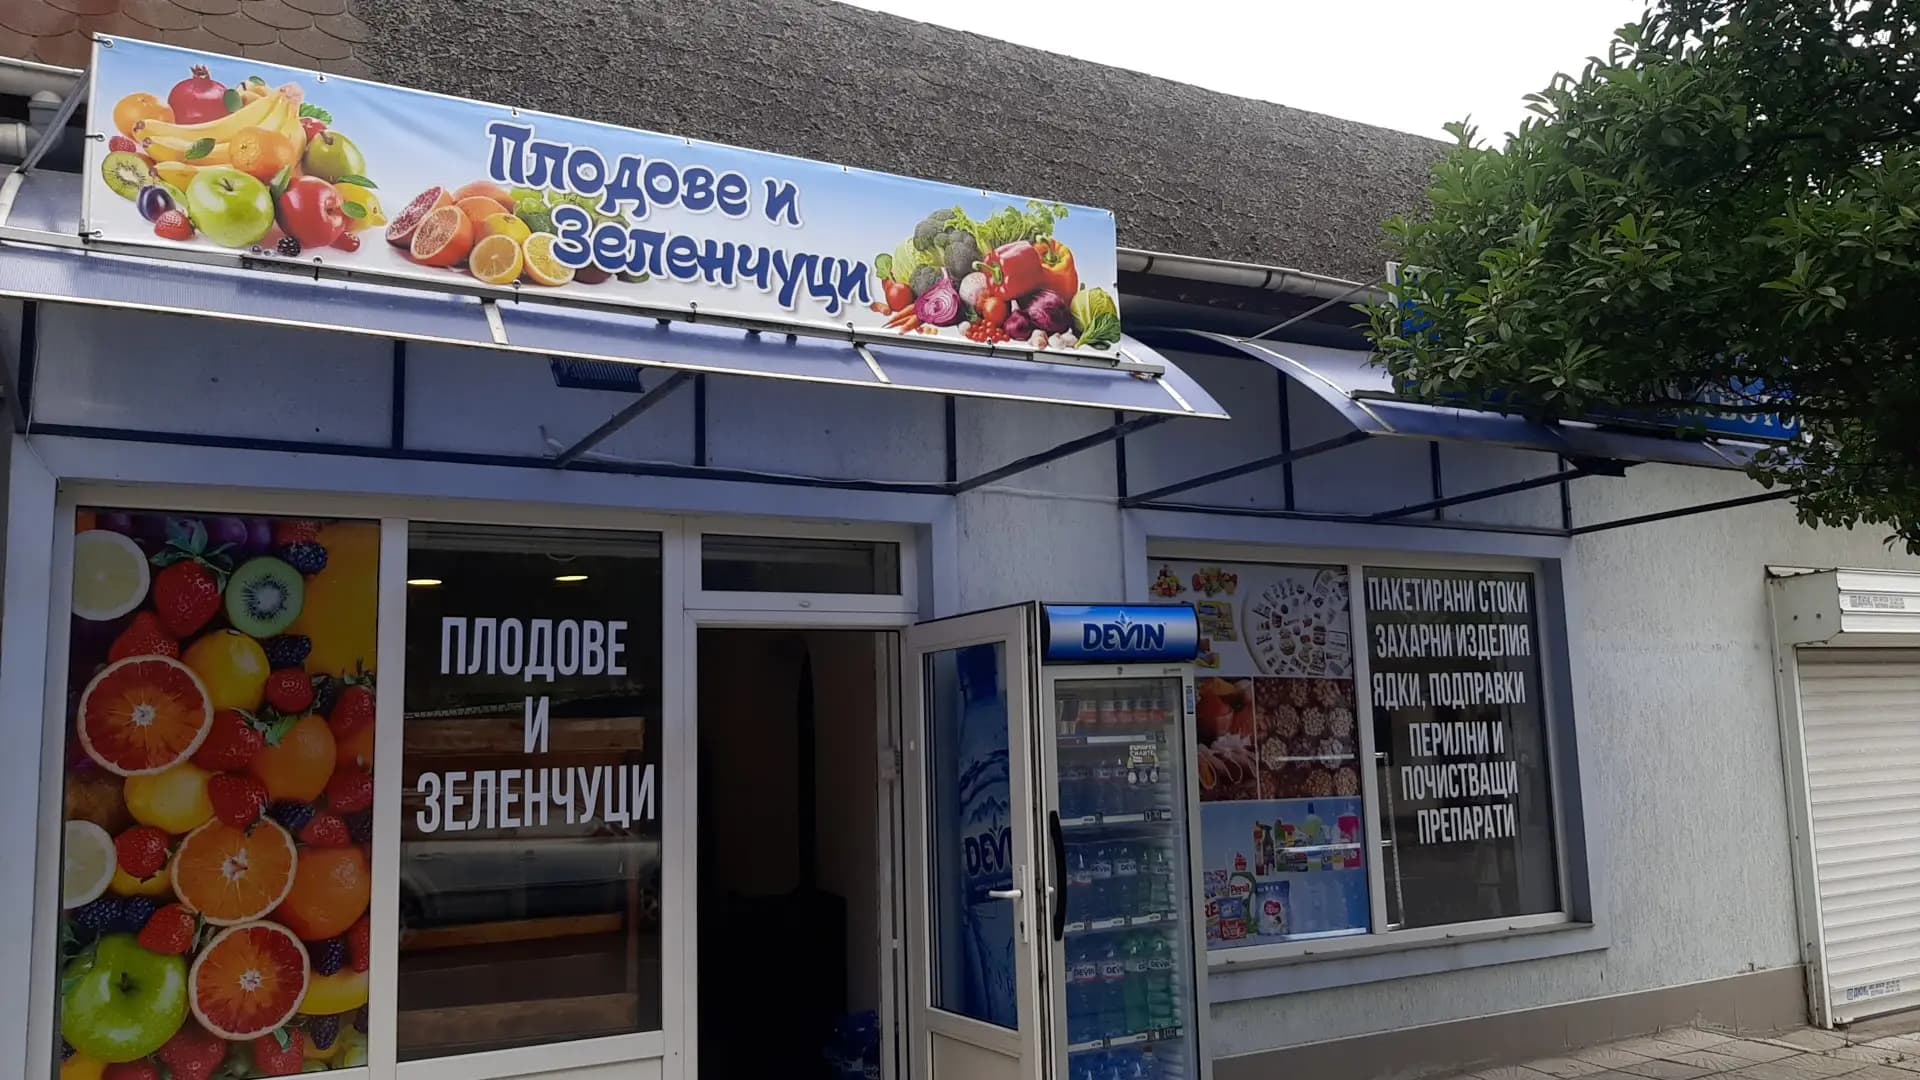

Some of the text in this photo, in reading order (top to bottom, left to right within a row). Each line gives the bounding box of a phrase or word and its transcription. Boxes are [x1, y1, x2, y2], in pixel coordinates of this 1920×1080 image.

[488, 122, 802, 226] Плодове и
[552, 206, 872, 315] Зеленчуци
[1367, 577, 1528, 613] ПАКЕТИРАНИ СТОКИ
[440, 616, 629, 683] ПЛОДОВЕ
[1082, 622, 1165, 650] DEVIN
[1375, 624, 1530, 660] ЗАХАРНИ ИЗДЕЛИЯ
[1373, 671, 1526, 711] ЯДКИ, ПОДПРАВКИ
[523, 695, 549, 754] И
[1408, 720, 1505, 757] ПЕРИЛНИ И
[416, 763, 655, 833] ЗЕЛЕНЧУЦИ
[1400, 761, 1518, 800] ПОЧИСТВАЩИ
[1416, 804, 1516, 844] ПРЕПАРАТИ
